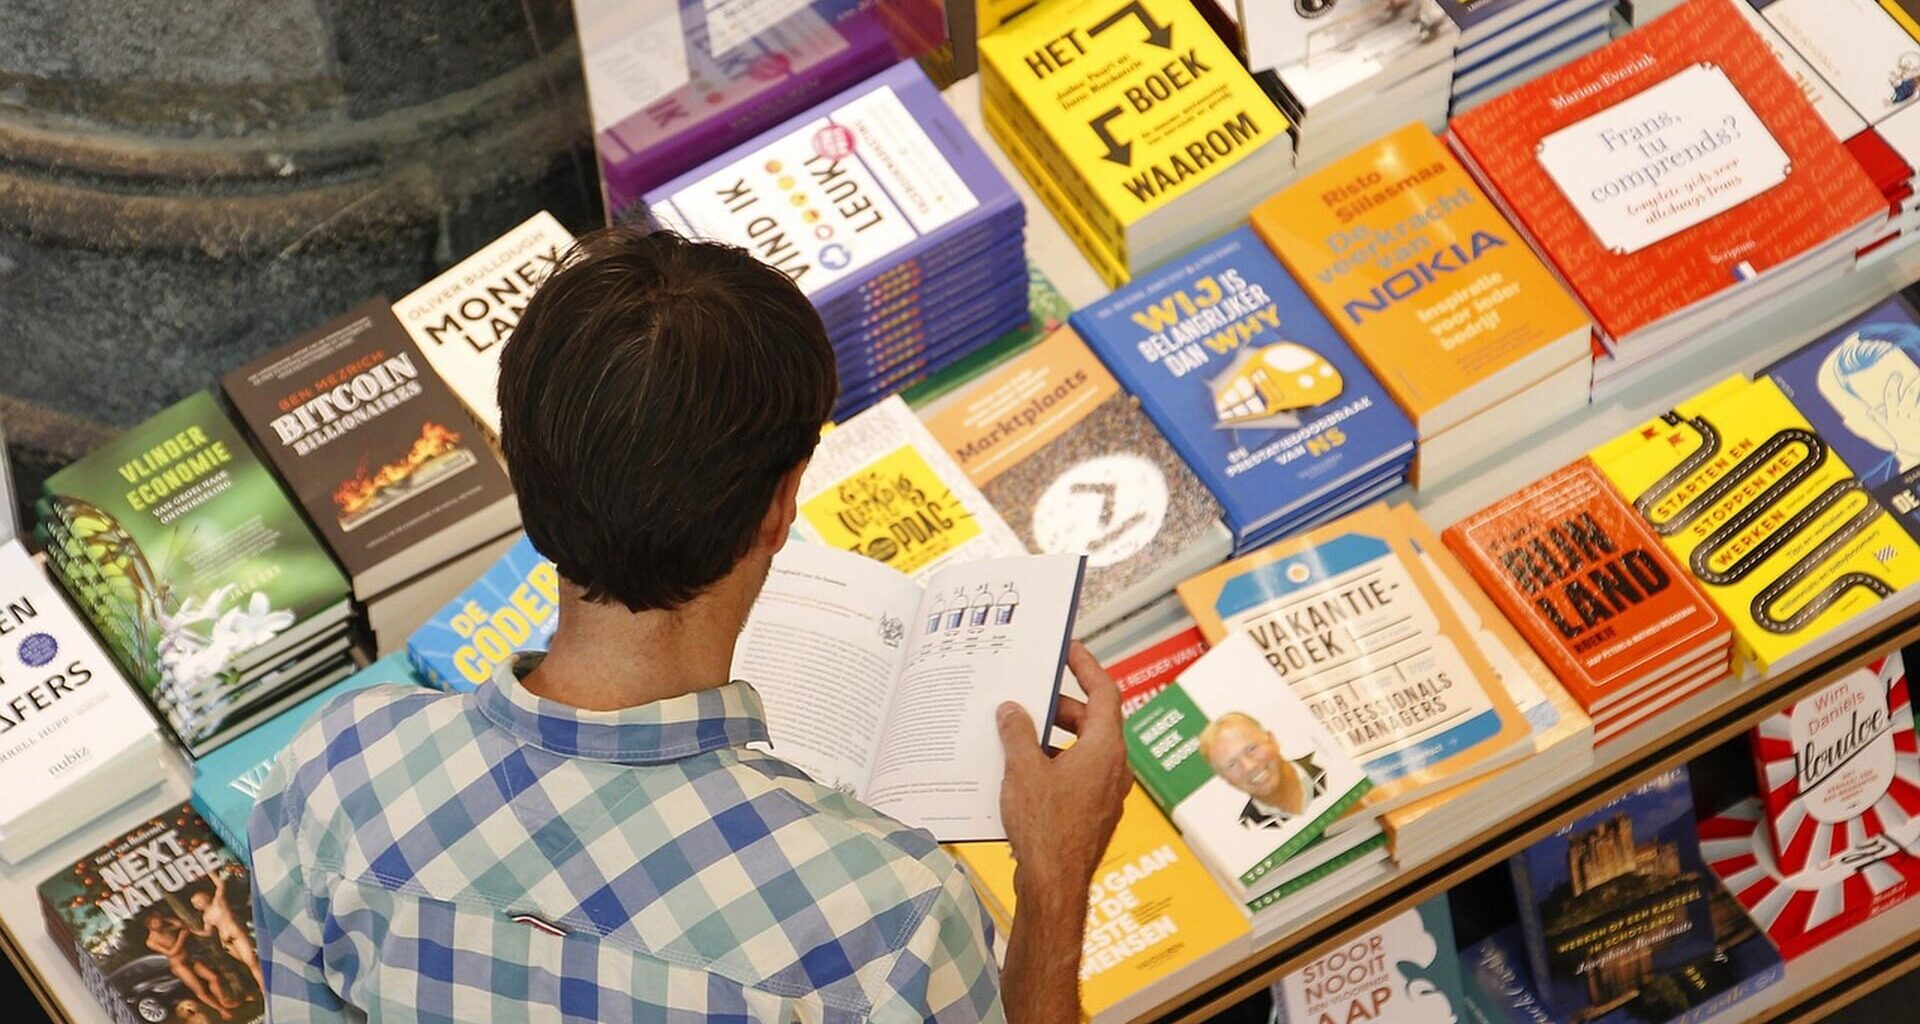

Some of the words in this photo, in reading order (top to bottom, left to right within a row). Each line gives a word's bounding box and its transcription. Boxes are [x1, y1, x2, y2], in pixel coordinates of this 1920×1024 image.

[1024, 28, 1089, 80] HET
[1123, 48, 1211, 114] BOEK
[1550, 79, 1602, 110] Marion
[1601, 52, 1657, 90] Everink
[1597, 106, 1683, 154] Frans,
[1637, 133, 1669, 160] tu
[1123, 111, 1261, 203] WAAROM
[1590, 114, 1743, 203] comprends?
[716, 177, 761, 215] IK
[1321, 171, 1382, 208] Risto
[747, 216, 811, 283] VIND
[1317, 187, 1475, 284] veerkracht
[1326, 224, 1369, 255] De
[1376, 236, 1432, 269] van
[408, 282, 461, 321] OLIVER
[425, 244, 562, 346] MONEY
[1132, 276, 1224, 333] WIJ
[1219, 268, 1248, 295] IS
[1343, 229, 1508, 325] NOKIA
[1417, 272, 1504, 323] Inspiratie
[1137, 283, 1272, 363] BELANGRIJKER
[1429, 308, 1472, 337] voor
[1472, 282, 1522, 318] ieder
[1440, 311, 1501, 352] bedrijf
[1163, 345, 1210, 378] DAN
[1204, 304, 1282, 355] WHY
[269, 351, 419, 447] BITCOIN
[277, 390, 312, 412] BEN
[315, 350, 386, 392] MEZRICH
[292, 378, 423, 457] BILLIONAIRES
[957, 366, 1089, 463] Marktplaats
[118, 424, 208, 486] VLINDER
[1276, 446, 1307, 466] VAN
[1306, 427, 1347, 457] NS
[125, 440, 233, 511] ECONOMIE
[1656, 455, 1731, 519] STARTEN
[1729, 437, 1754, 461] EN
[1693, 477, 1768, 538] STOPPEN
[1768, 447, 1802, 480] MET
[1892, 485, 1920, 516] DE
[152, 502, 173, 519] VAN
[1501, 509, 1619, 596] RIJN
[1714, 510, 1787, 568] WERKEN
[1248, 577, 1400, 652] VAKANTIE-
[1535, 545, 1673, 640] LAND
[450, 600, 490, 639] DE
[1572, 626, 1617, 656] BOEKJE
[1128, 656, 1173, 686] REDDER
[1172, 644, 1200, 666] VAN
[1265, 629, 1345, 677] BOEK
[1348, 696, 1447, 748] MANAGERS
[1807, 690, 1866, 736] Daniels
[1814, 684, 1849, 713] Wim
[1140, 709, 1186, 747] MARCEL
[1149, 731, 1182, 761] BOEK
[48, 743, 92, 776] nubiz
[99, 829, 188, 892] NEXT
[100, 843, 222, 925] NATURE
[1104, 845, 1180, 893] GAAN
[1245, 859, 1275, 883] TOP
[1105, 888, 1138, 919] DE
[1252, 890, 1282, 911] TOP
[1081, 918, 1180, 981] MENSEN
[1556, 925, 1609, 955] WERKEN
[1601, 911, 1677, 949] SCHOTLAND
[1303, 933, 1385, 981] STOOR
[1304, 955, 1387, 1003] NOOIT
